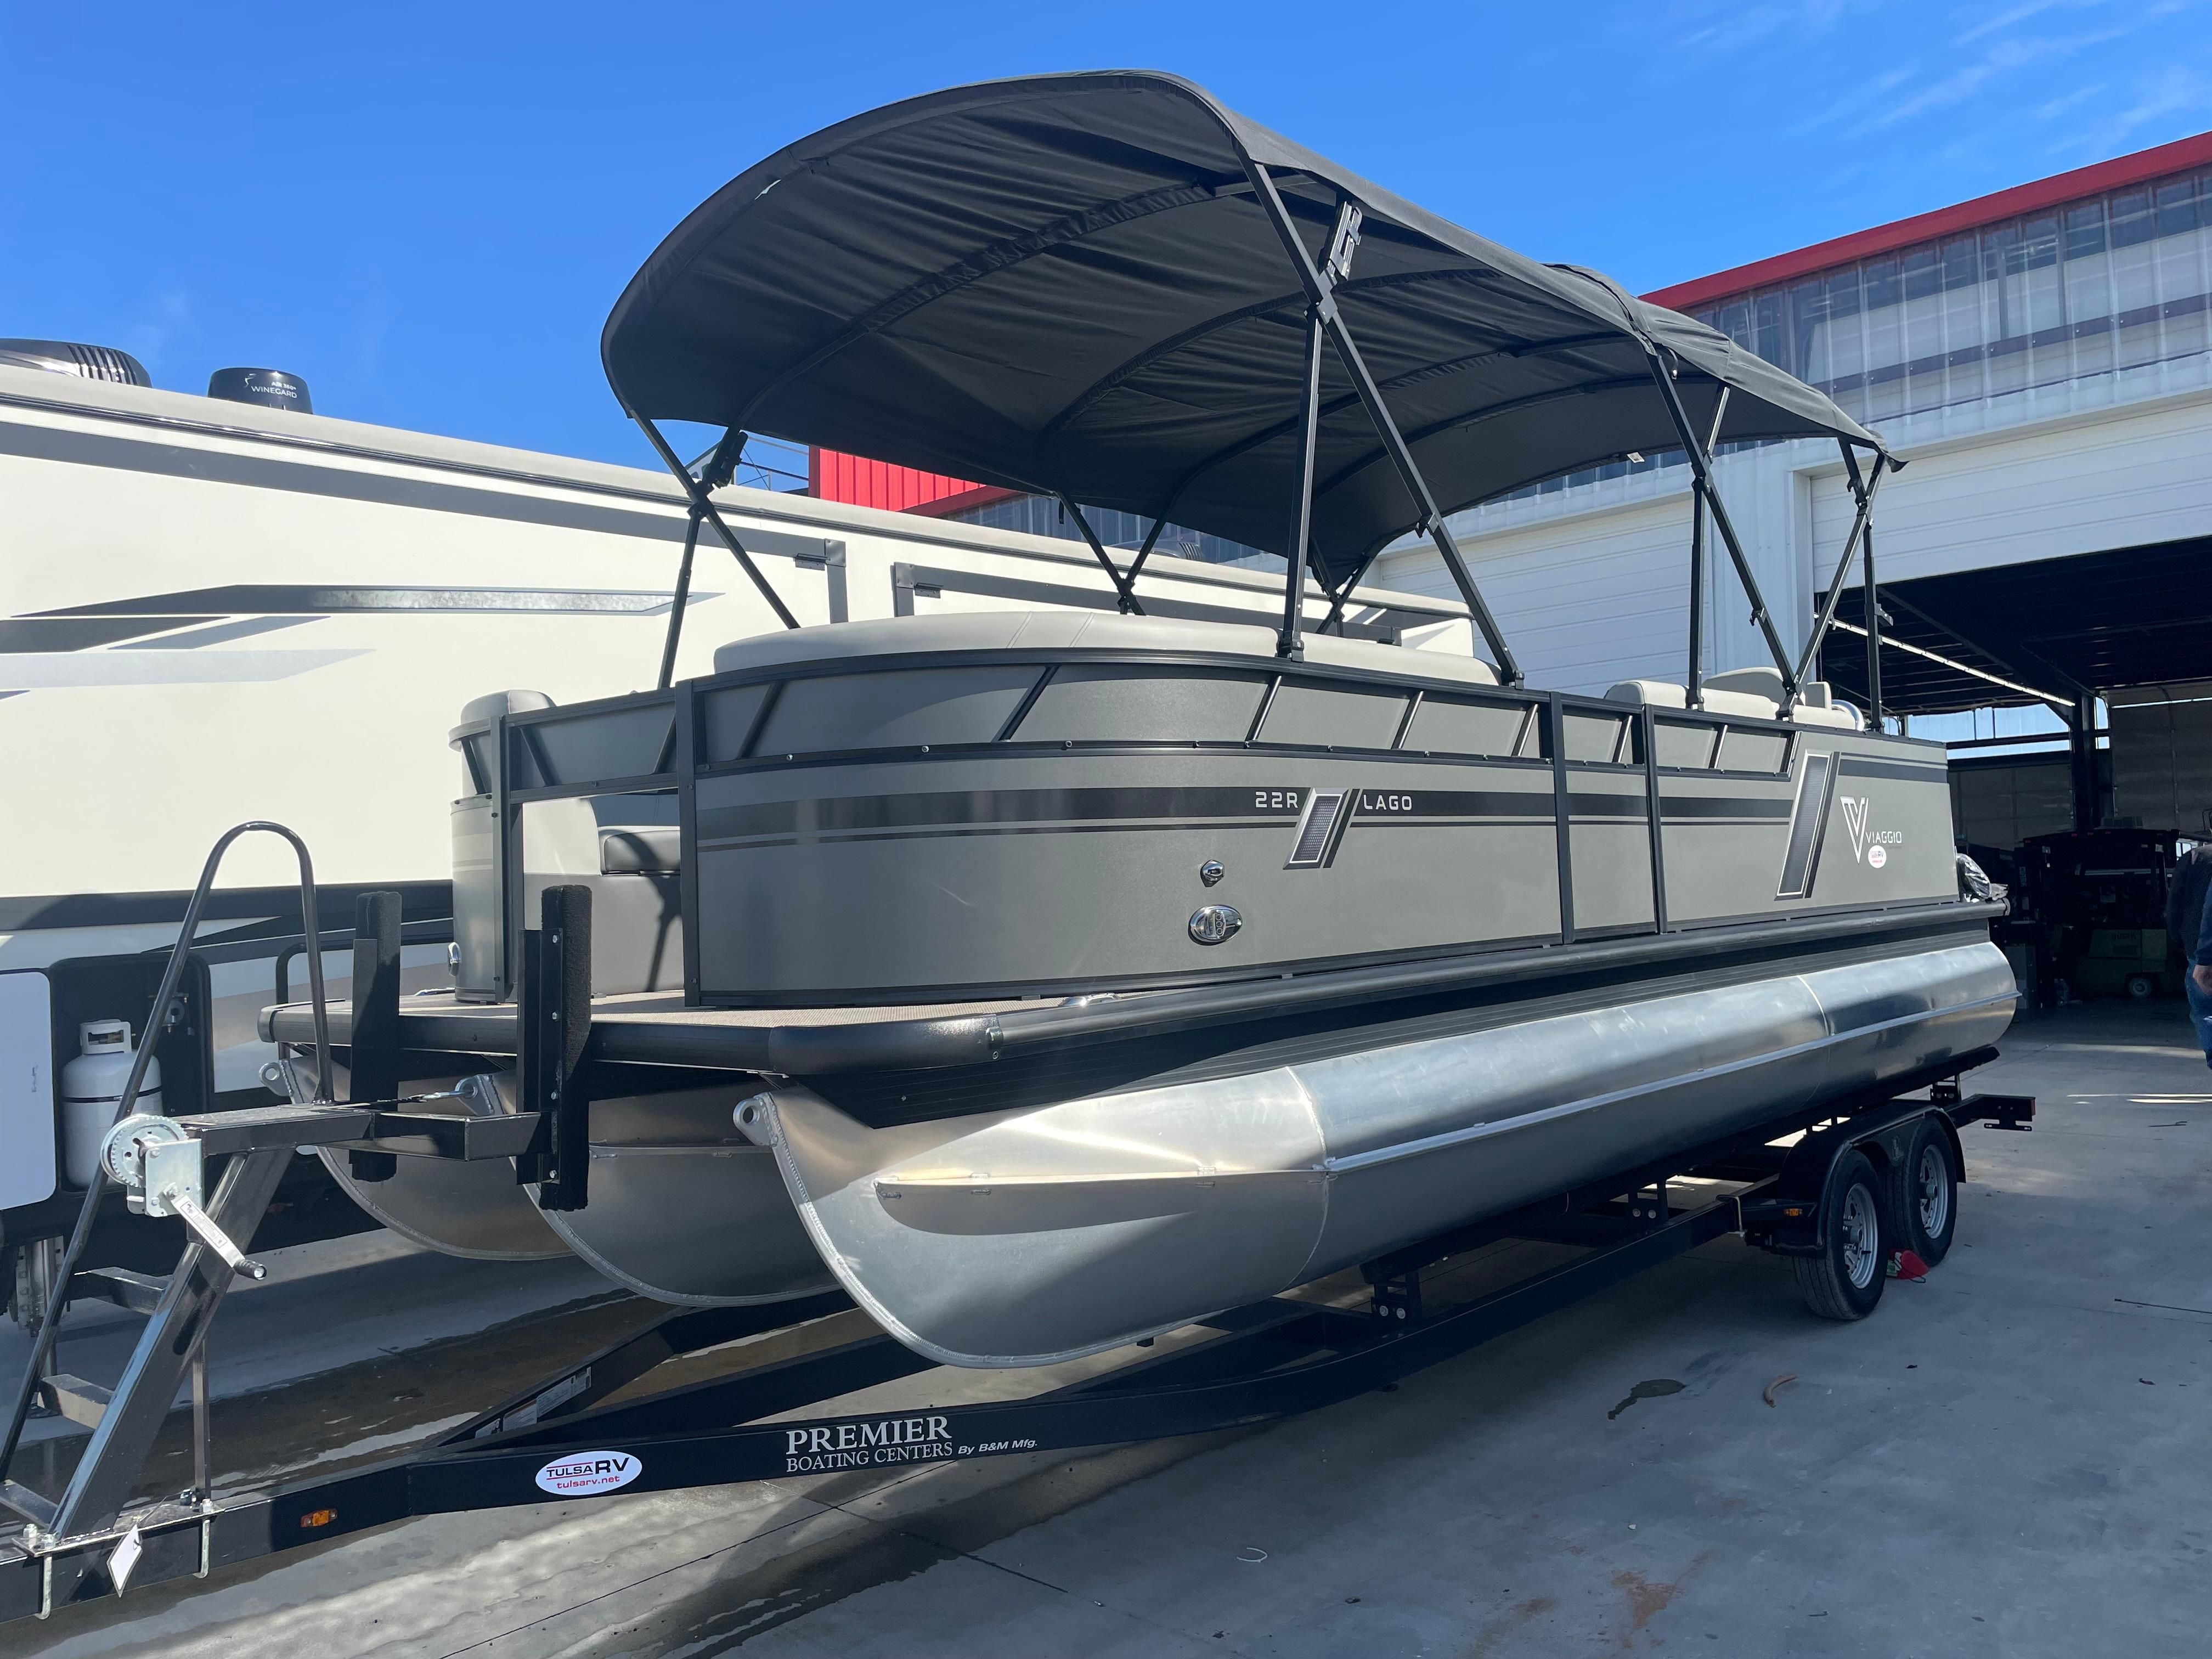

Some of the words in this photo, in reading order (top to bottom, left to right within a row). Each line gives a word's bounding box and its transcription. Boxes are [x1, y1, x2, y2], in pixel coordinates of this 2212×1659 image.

[251, 386, 297, 398] WINEGARD
[1255, 791, 1299, 809] 22R
[1363, 794, 1413, 811] LAGO
[1865, 831, 1902, 844] VIAGGIO
[786, 1416, 952, 1455] PREMIER
[786, 1451, 870, 1472] BOATING
[874, 1442, 952, 1464] CENTERS
[958, 1445, 975, 1456] By
[978, 1441, 1008, 1452] B&M
[1012, 1438, 1038, 1449] Mfg.
[556, 1475, 620, 1489] tulsarv.net
